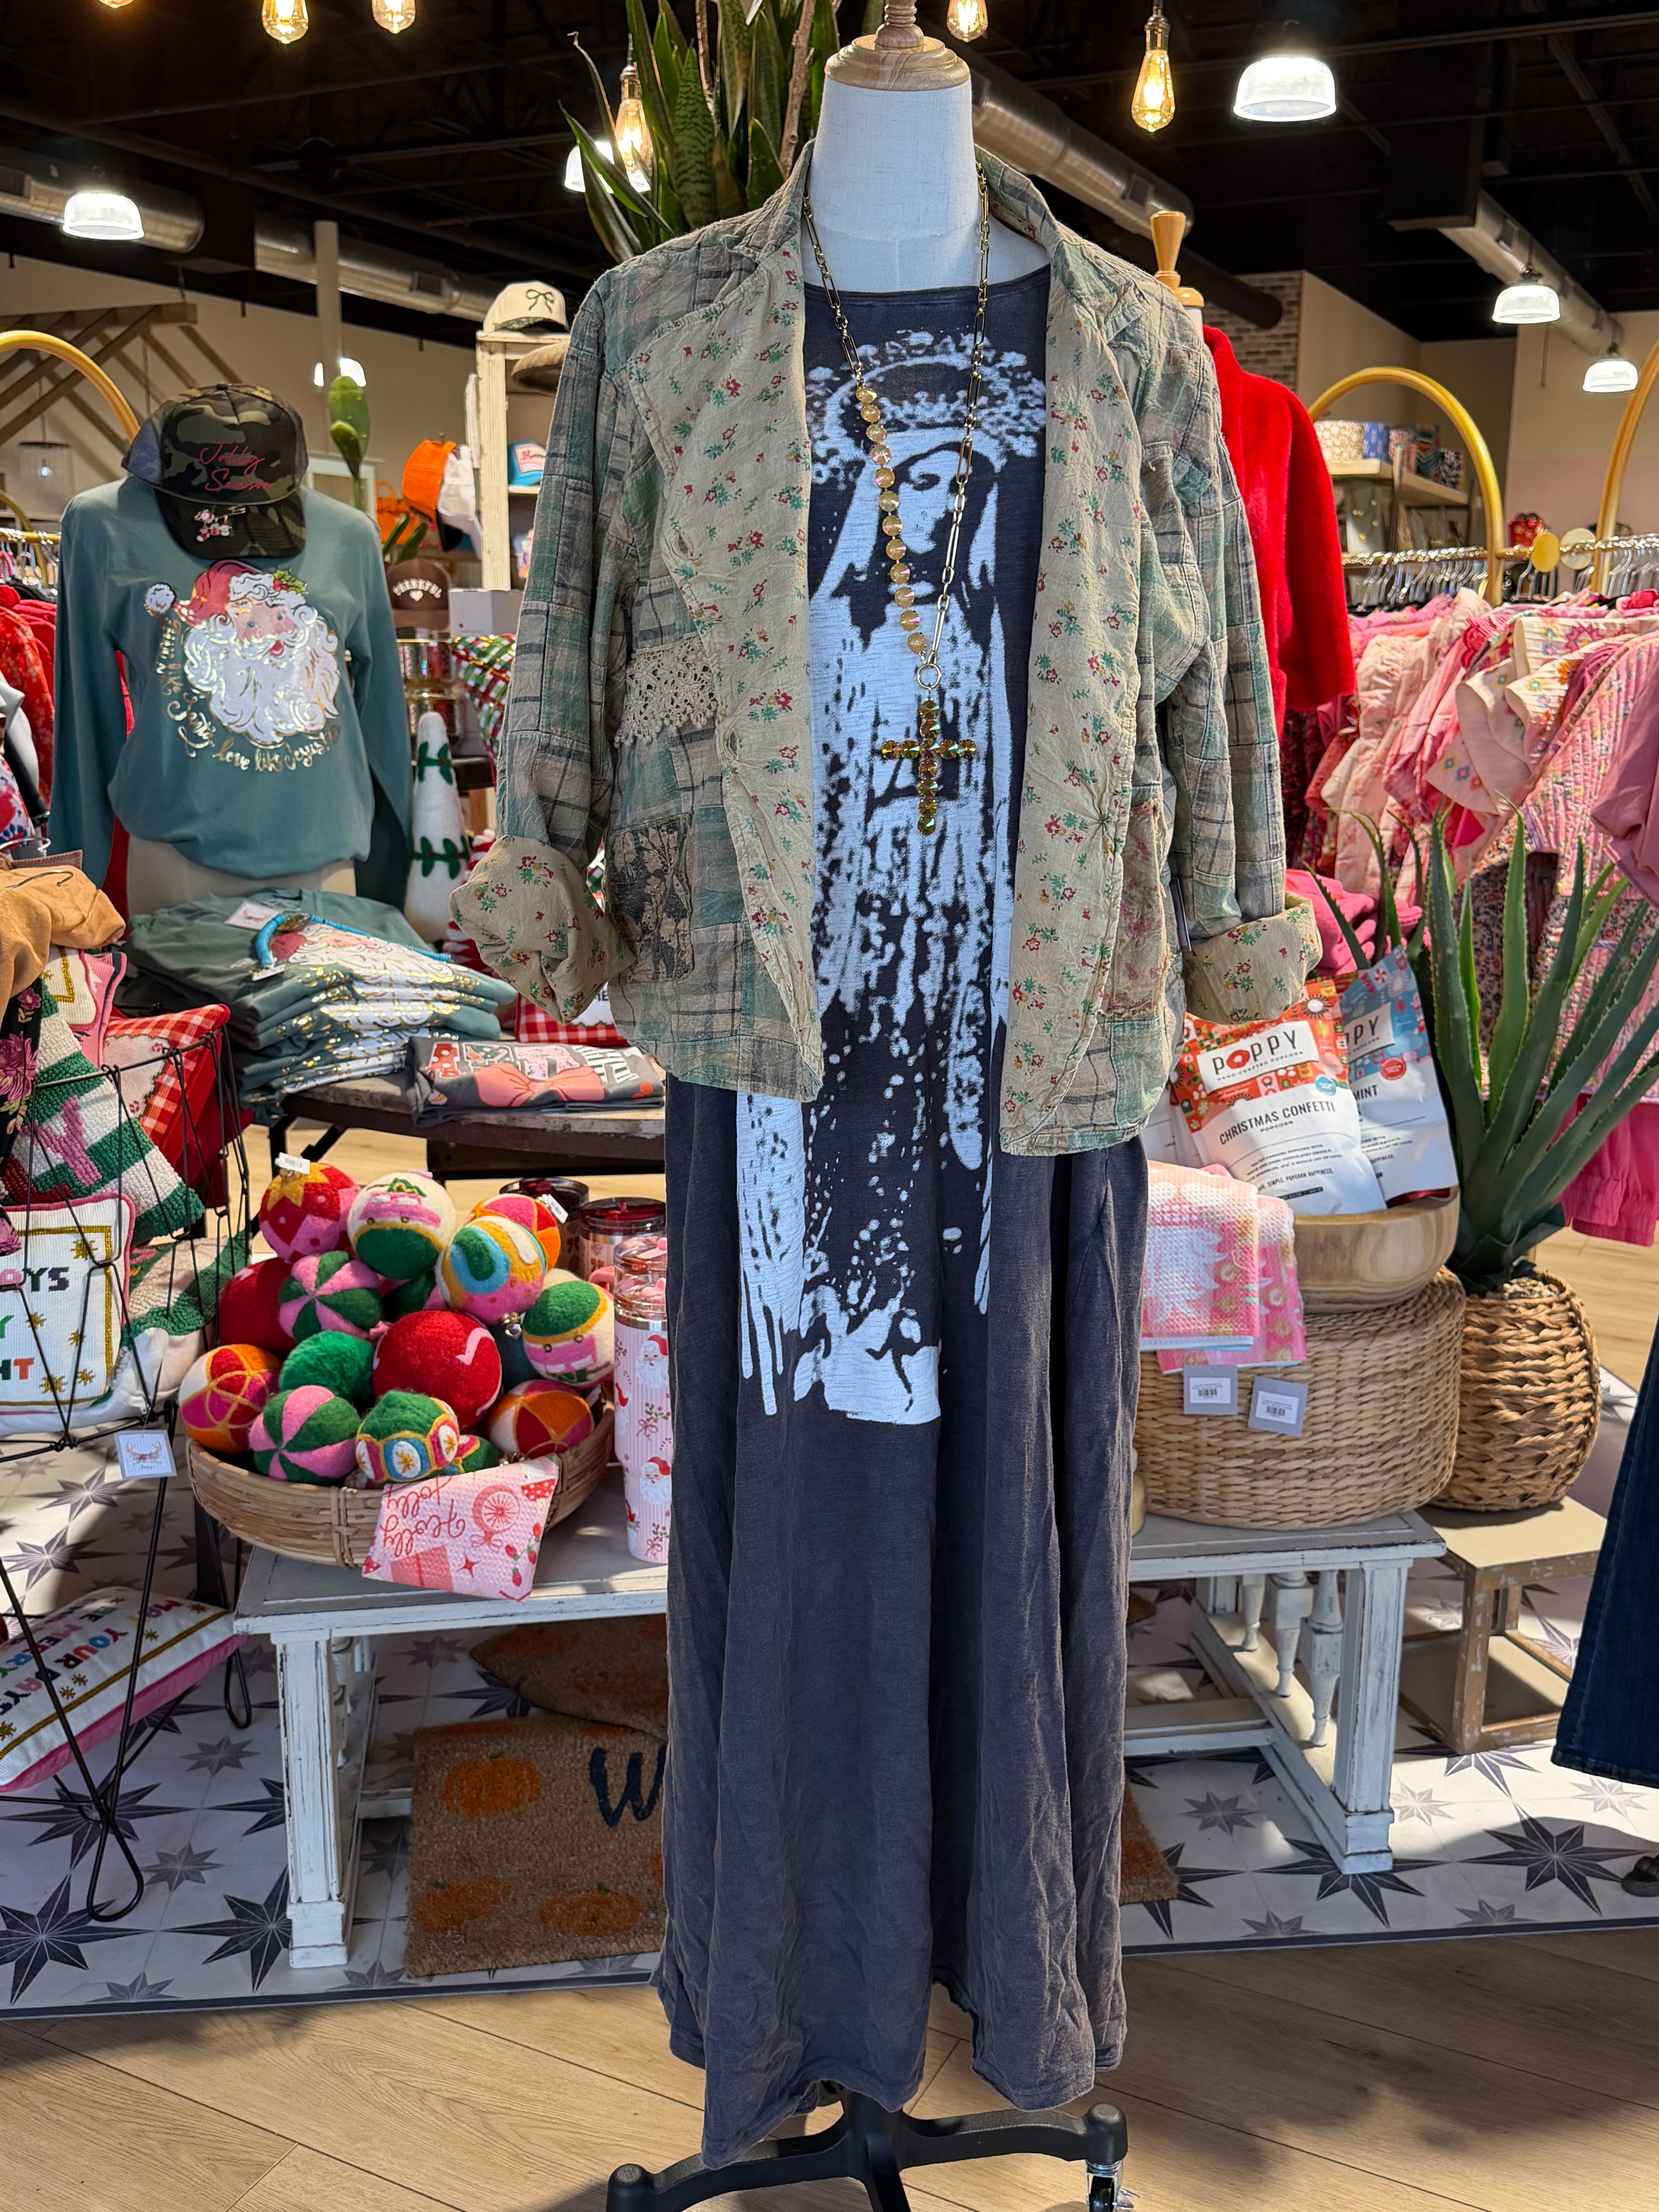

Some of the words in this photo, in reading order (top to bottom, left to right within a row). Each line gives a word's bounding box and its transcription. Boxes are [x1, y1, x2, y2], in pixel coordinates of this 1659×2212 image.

[199, 440, 265, 477] Jolly
[213, 737, 250, 770] love
[1212, 1029, 1297, 1075] POPPY
[1219, 1111, 1279, 1145] CHRISTMAS
[1282, 1101, 1336, 1118] CONFETTI
[1260, 1120, 1294, 1133] POPCORN
[380, 1499, 465, 1558] Holly
[79, 1606, 118, 1623] BE
[55, 1627, 129, 1669] YOUR
